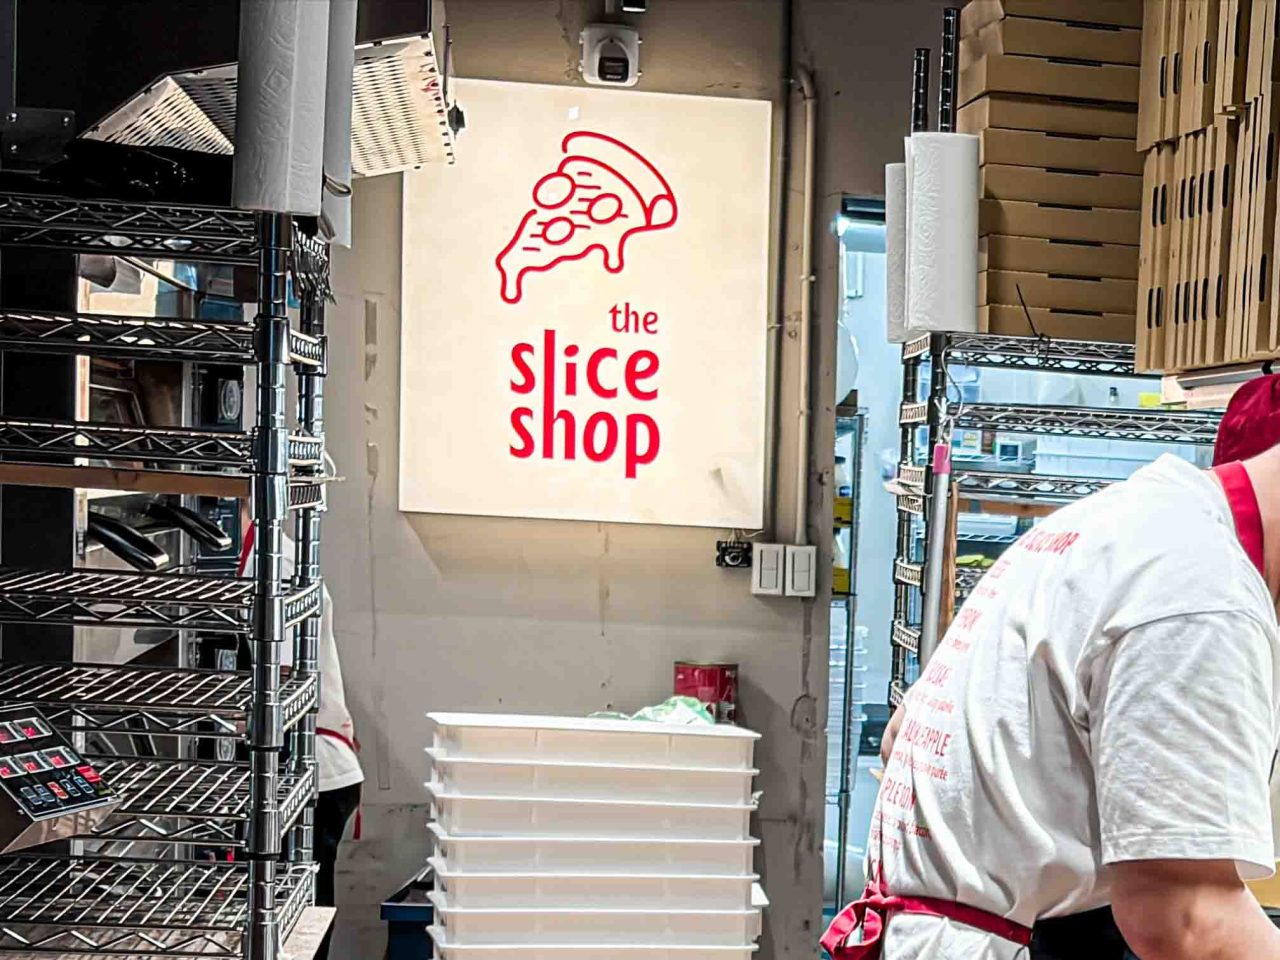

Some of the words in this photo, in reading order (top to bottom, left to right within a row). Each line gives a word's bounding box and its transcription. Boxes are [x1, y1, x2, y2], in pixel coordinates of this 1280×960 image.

[609, 303, 660, 335] the
[510, 329, 660, 402] slice
[509, 405, 661, 479] shop
